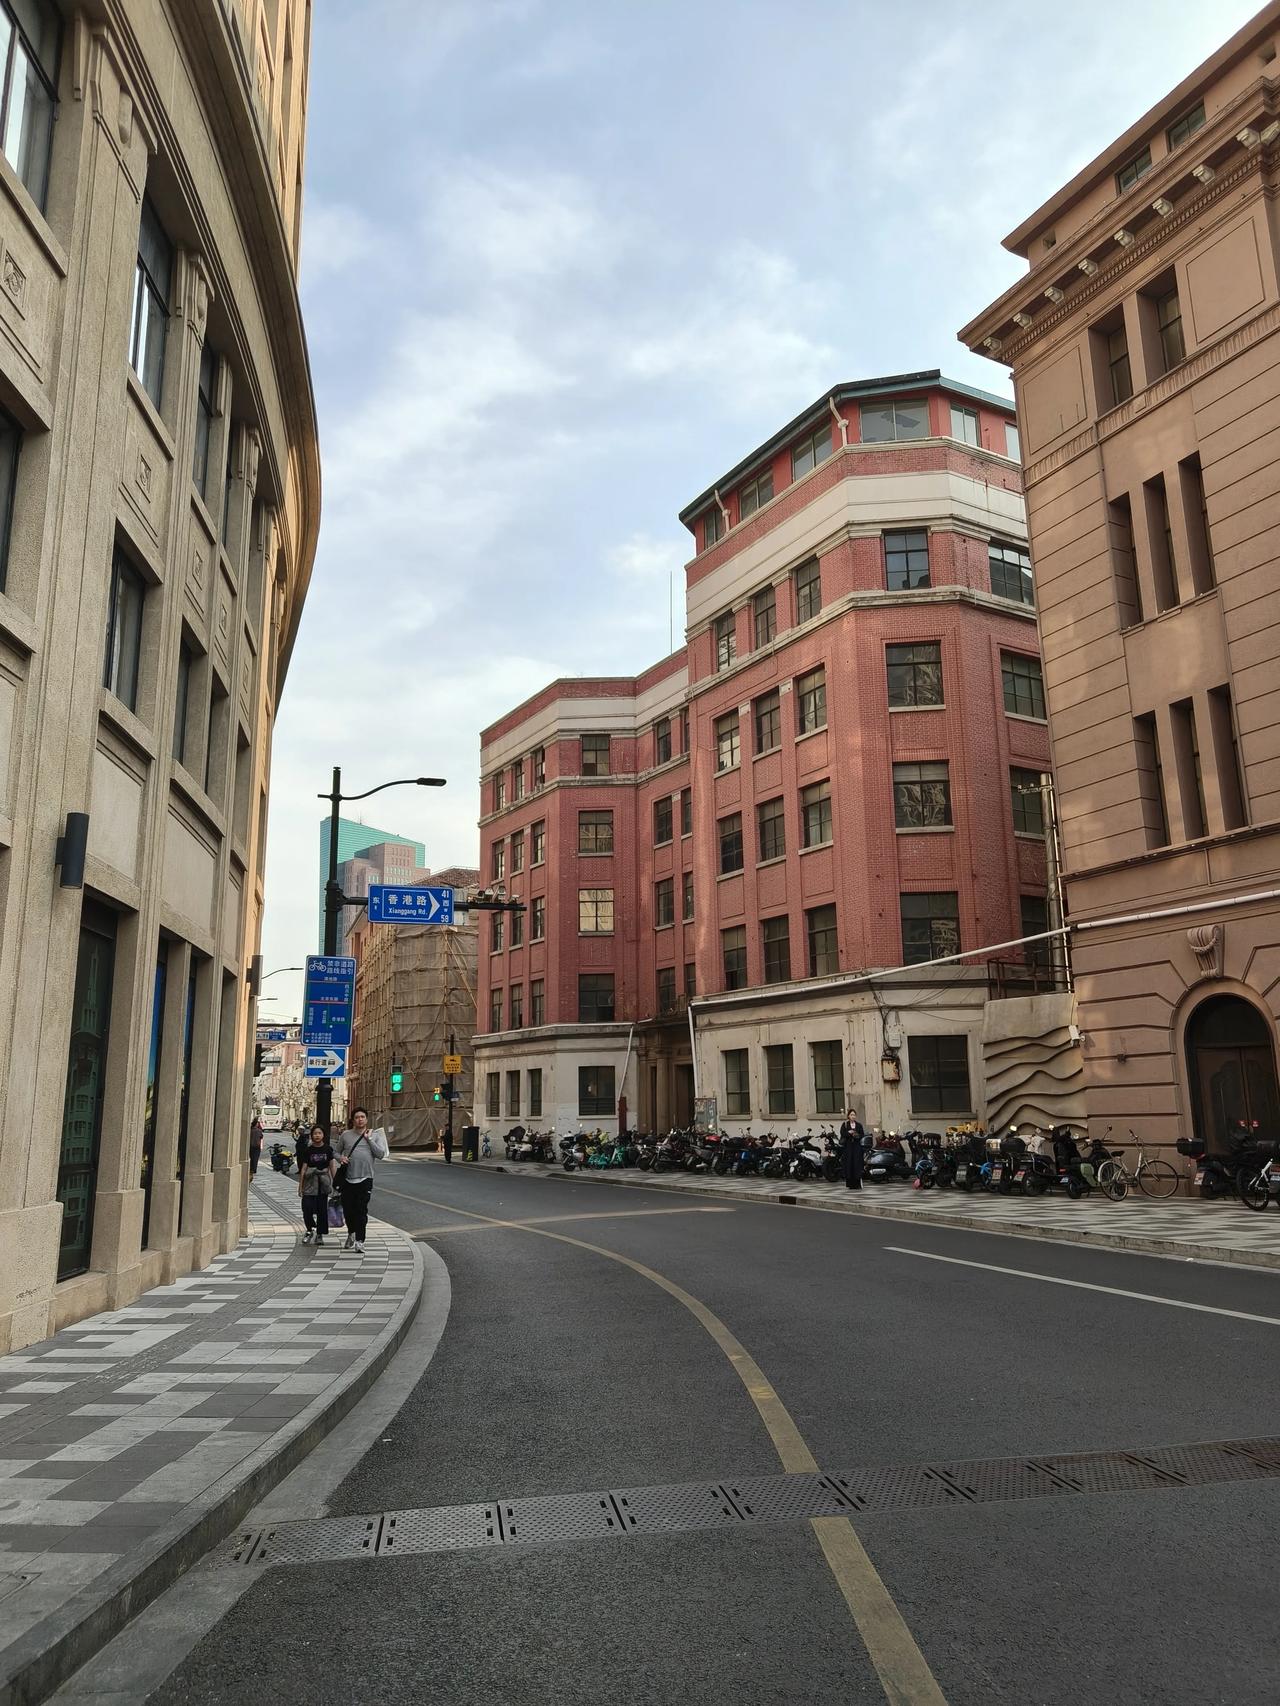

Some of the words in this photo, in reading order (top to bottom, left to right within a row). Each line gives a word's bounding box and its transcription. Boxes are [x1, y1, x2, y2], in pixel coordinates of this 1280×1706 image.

[441, 890, 449, 898] 41
[388, 895, 427, 906] 香港路
[443, 899, 449, 907] 西
[388, 907, 417, 916] Xianggang
